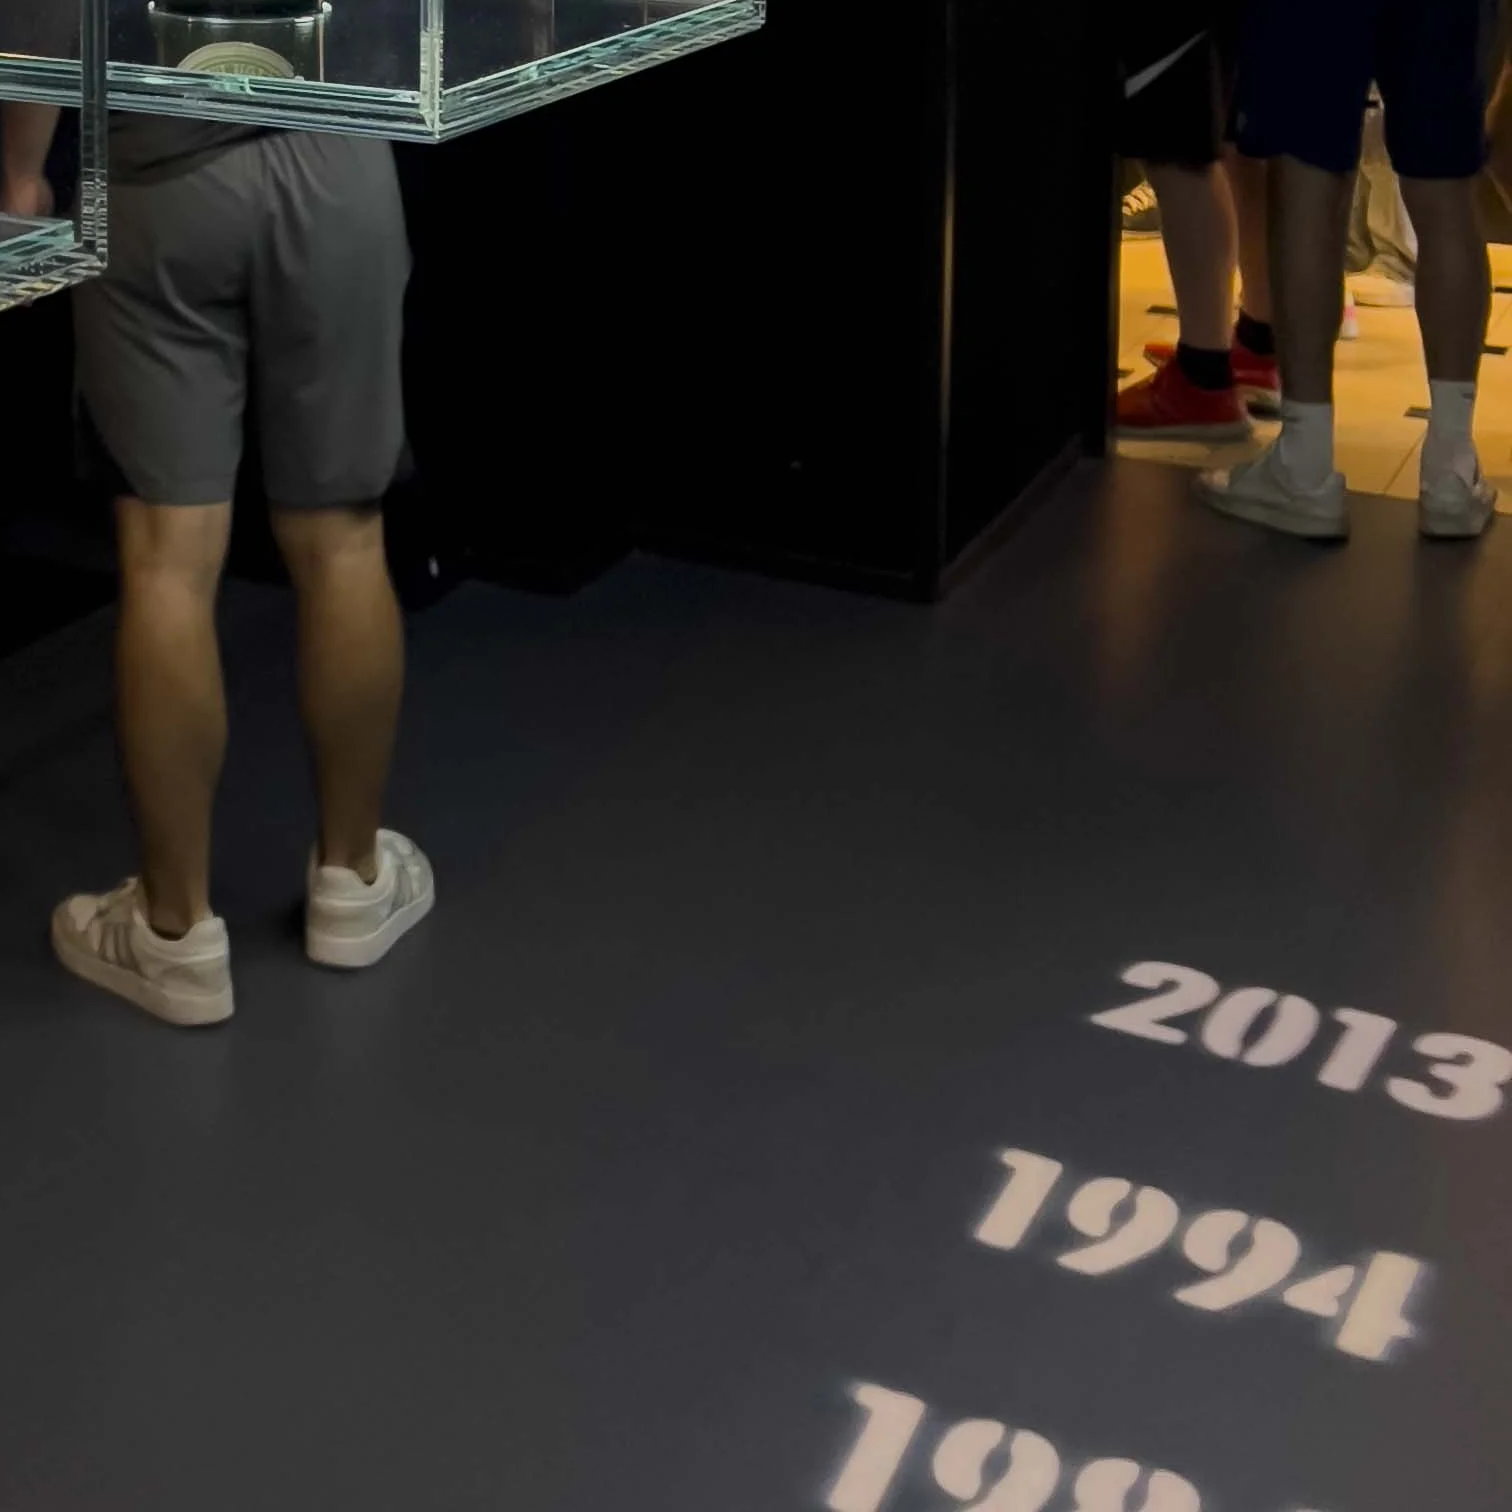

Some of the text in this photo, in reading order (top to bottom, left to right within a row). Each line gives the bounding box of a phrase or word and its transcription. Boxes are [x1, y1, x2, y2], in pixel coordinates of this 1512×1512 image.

[1090, 960, 1512, 1121] 2013
[974, 1146, 1422, 1363] 1994
[825, 1382, 1324, 1512] 19
